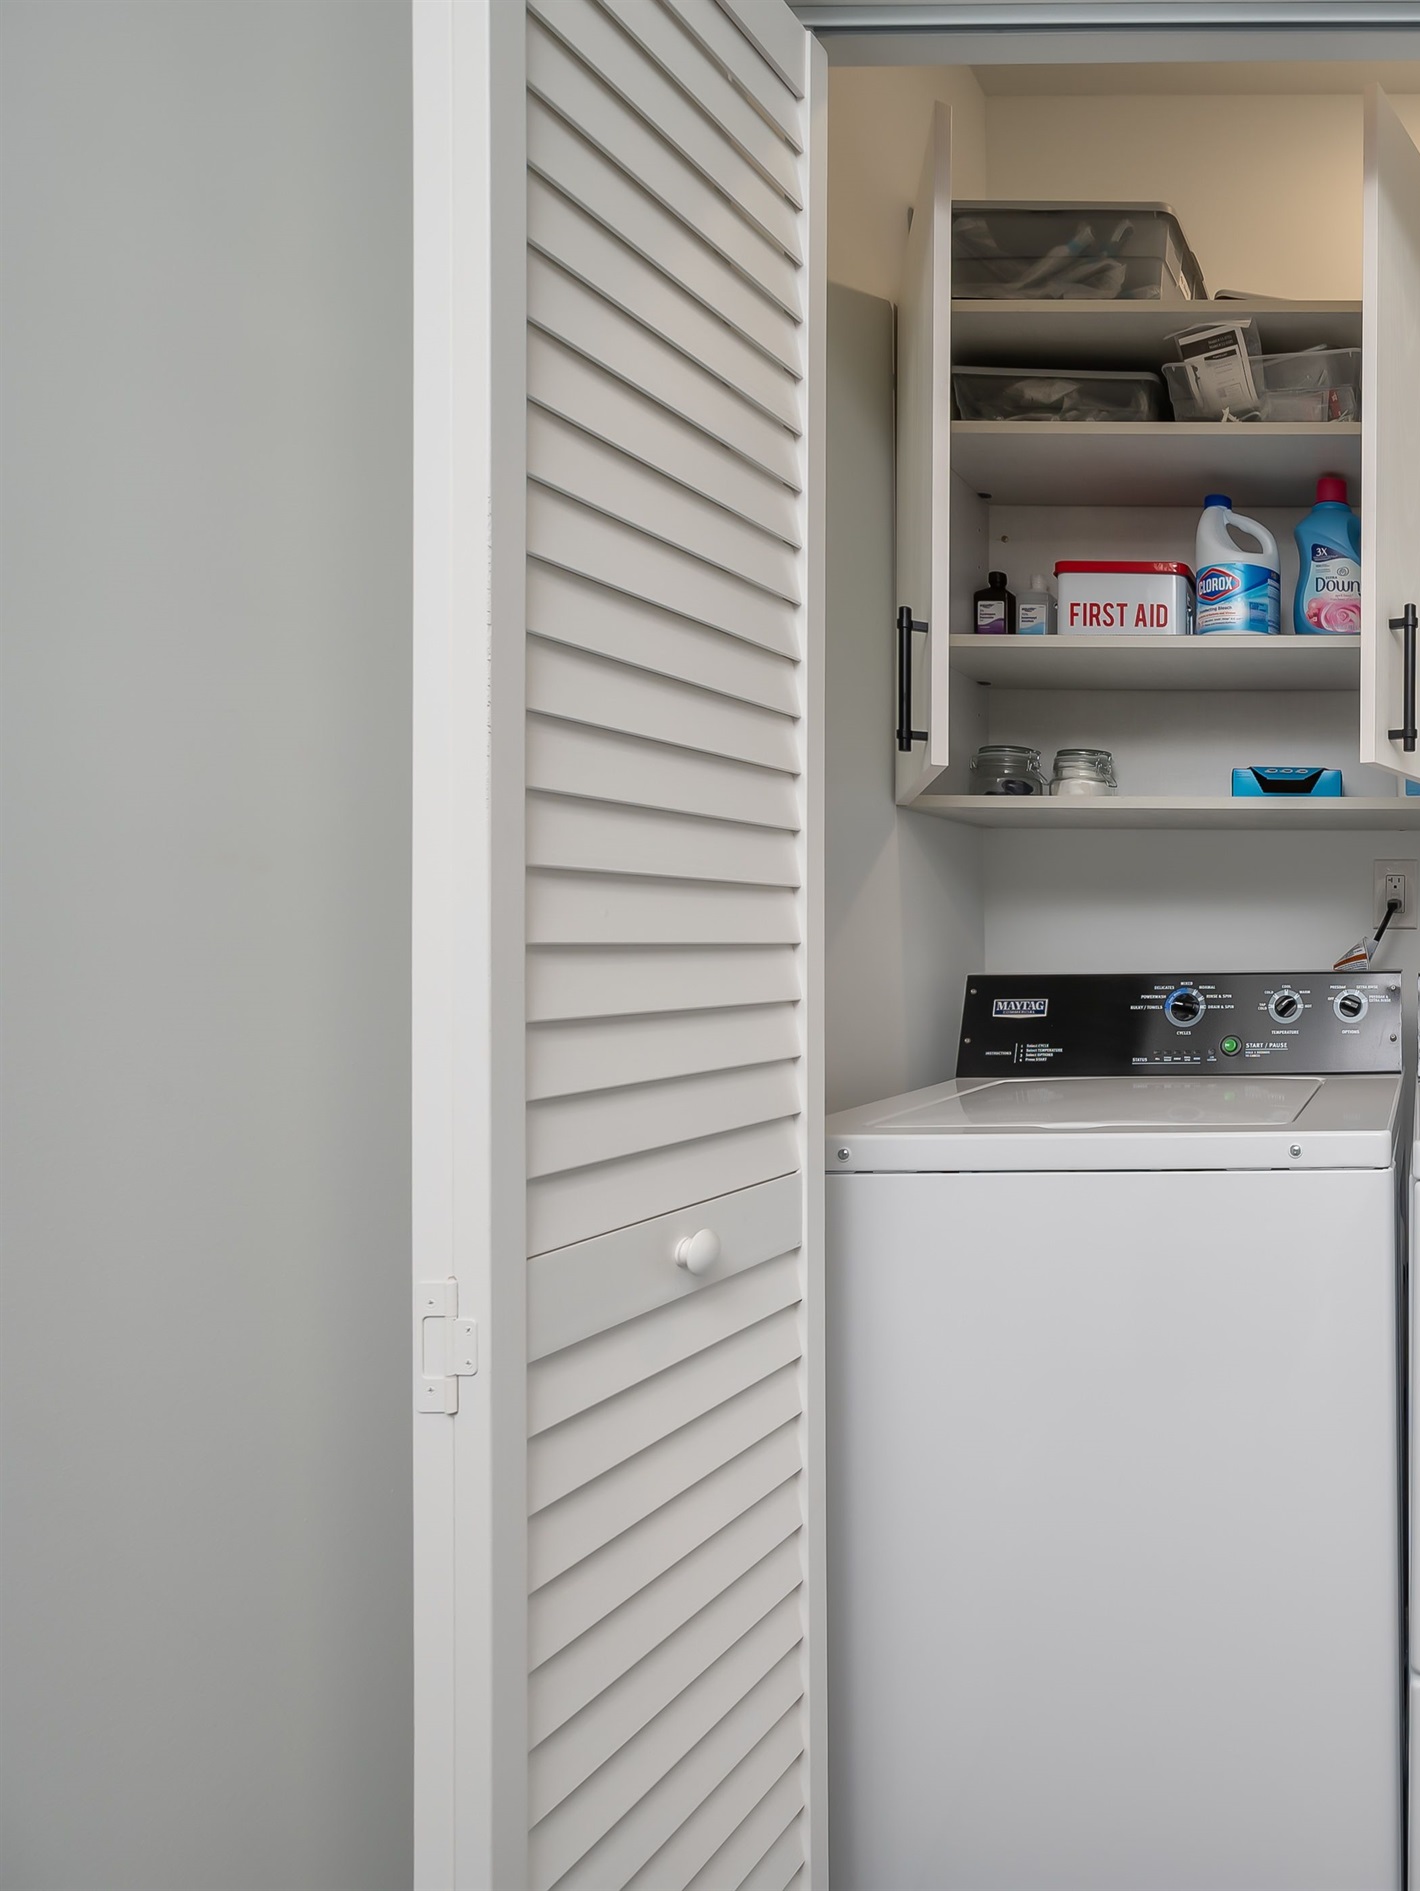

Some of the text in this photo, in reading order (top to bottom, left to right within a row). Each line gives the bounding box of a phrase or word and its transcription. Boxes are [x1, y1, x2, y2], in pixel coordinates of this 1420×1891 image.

[1316, 548, 1328, 556] 3X
[1200, 576, 1232, 595] CLOROX
[1070, 603, 1168, 628] FIRST AID
[996, 1001, 1044, 1010] MAYTAG
